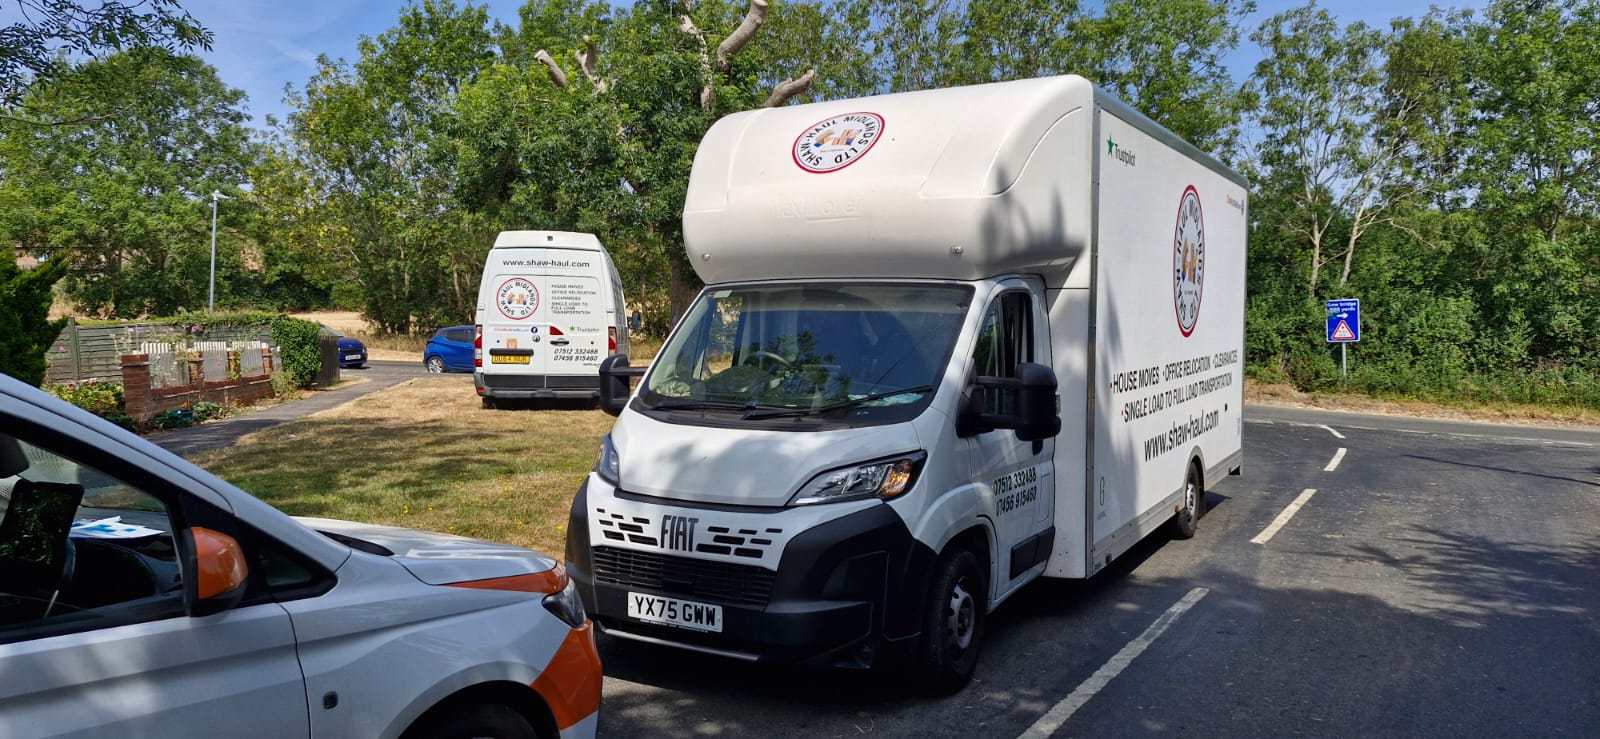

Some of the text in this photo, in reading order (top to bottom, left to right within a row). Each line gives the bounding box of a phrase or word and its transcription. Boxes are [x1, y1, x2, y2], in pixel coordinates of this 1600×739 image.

[800, 115, 877, 166] SHAW-HAUL MIDLANDS LTD
[1114, 143, 1136, 167] Trustpilot
[502, 259, 590, 268] www.shaw-haul.com
[1112, 349, 1238, 394] HOUSE MOVES OFFICE RELOCATION CLEARANCES
[1124, 371, 1233, 423] SINGLE LOAD TO FULL LOAD TRANSPORTATION
[1144, 409, 1219, 462] www.shaw-haul.com
[993, 467, 1037, 497] 07512 332488
[996, 485, 1037, 517] 07456 915460
[660, 514, 699, 552] FIAT
[635, 595, 678, 620] YX75
[682, 603, 716, 626] GWW
